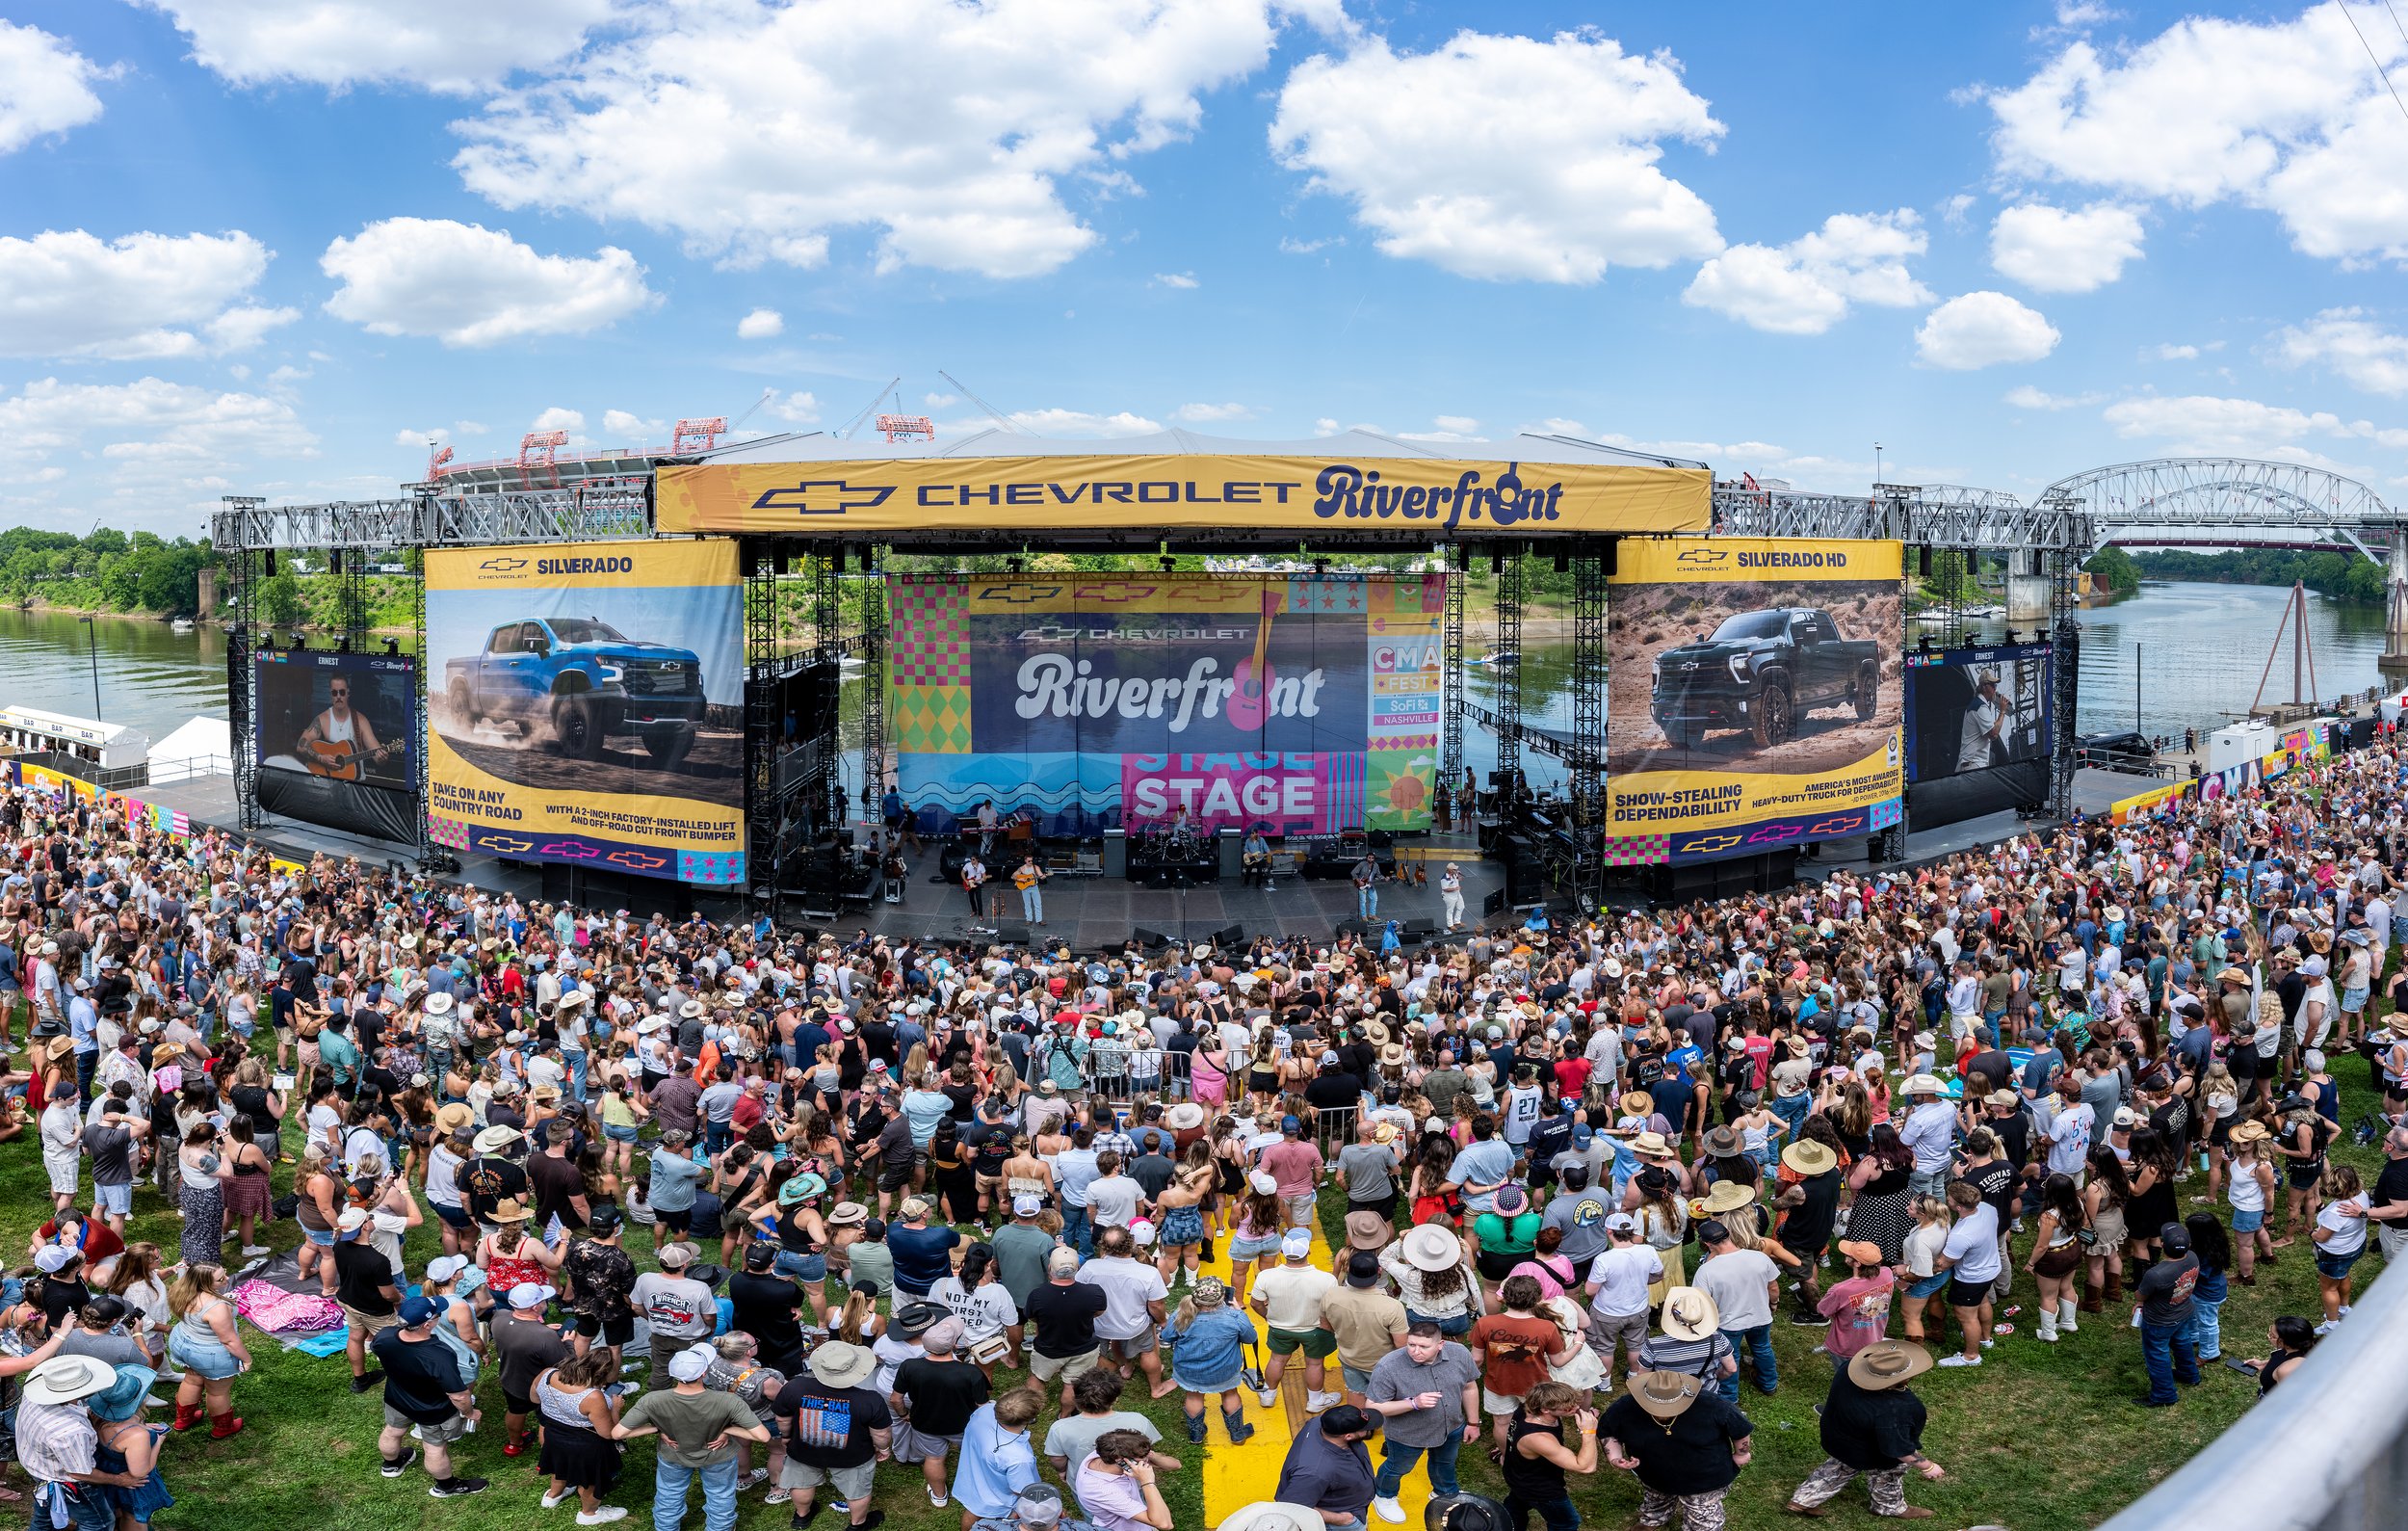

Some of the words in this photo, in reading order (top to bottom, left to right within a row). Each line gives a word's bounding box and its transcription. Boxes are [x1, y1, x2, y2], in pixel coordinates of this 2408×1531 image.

[917, 482, 1301, 507] CHEVROLET
[1313, 462, 1563, 529] Riverfront
[537, 557, 632, 574] SILVERADO
[1738, 551, 1823, 568] SILVERADO
[1826, 552, 1847, 568] HD
[1089, 628, 1249, 640] CHEVROLET
[256, 651, 275, 662] CMA
[318, 656, 339, 666] ERNEST
[1374, 646, 1440, 672] CMA
[1907, 655, 1930, 667] CMA
[1976, 651, 1995, 661] ERNEST
[1389, 676, 1429, 690] FEST
[1014, 652, 1325, 732] Riverfront
[1390, 700, 1416, 712] SoFi
[23, 718, 35, 726] BAR
[51, 724, 64, 732] BAR
[1384, 714, 1433, 725] NASHVILLE
[81, 730, 93, 740] BAR
[1804, 779, 1850, 793] AMERICA'S
[1852, 777, 1871, 786] MOST
[1871, 769, 1899, 782] AWARDED
[432, 781, 457, 798] TAKE
[458, 787, 476, 801] ON
[478, 790, 506, 805] ANY
[1134, 775, 1316, 817] STAGE
[1615, 783, 1742, 807] SHOW-STEALING
[1752, 794, 1808, 808] HEAVY-DUTY
[1808, 792, 1836, 802] TRUCK
[1838, 788, 1852, 798] FOR
[1853, 777, 1899, 795] DEPENDABILITY
[433, 795, 484, 815] COUNTRY
[484, 805, 523, 821] ROAD
[1614, 799, 1741, 822] DEPENDABILILTY
[545, 805, 573, 814] WITH
[574, 806, 581, 815] A
[582, 807, 610, 820] 2-INCH
[611, 812, 712, 831] FACTORY-INSTALLED
[713, 821, 736, 831] LIFT
[570, 815, 589, 826] AND
[589, 818, 634, 832] OFF-ROAD
[635, 825, 653, 835] CUT
[655, 827, 688, 838] FRONT
[689, 830, 736, 841] BUMPER
[1518, 1096, 1536, 1115] 27
[1978, 1169, 2011, 1188] TECOVAS
[655, 1294, 686, 1307] WRENCH
[945, 1292, 969, 1305] NOT
[973, 1298, 990, 1308] MY
[1489, 1329, 1539, 1345] Coors
[801, 1397, 824, 1410] THIS
[827, 1401, 851, 1414] BAR
